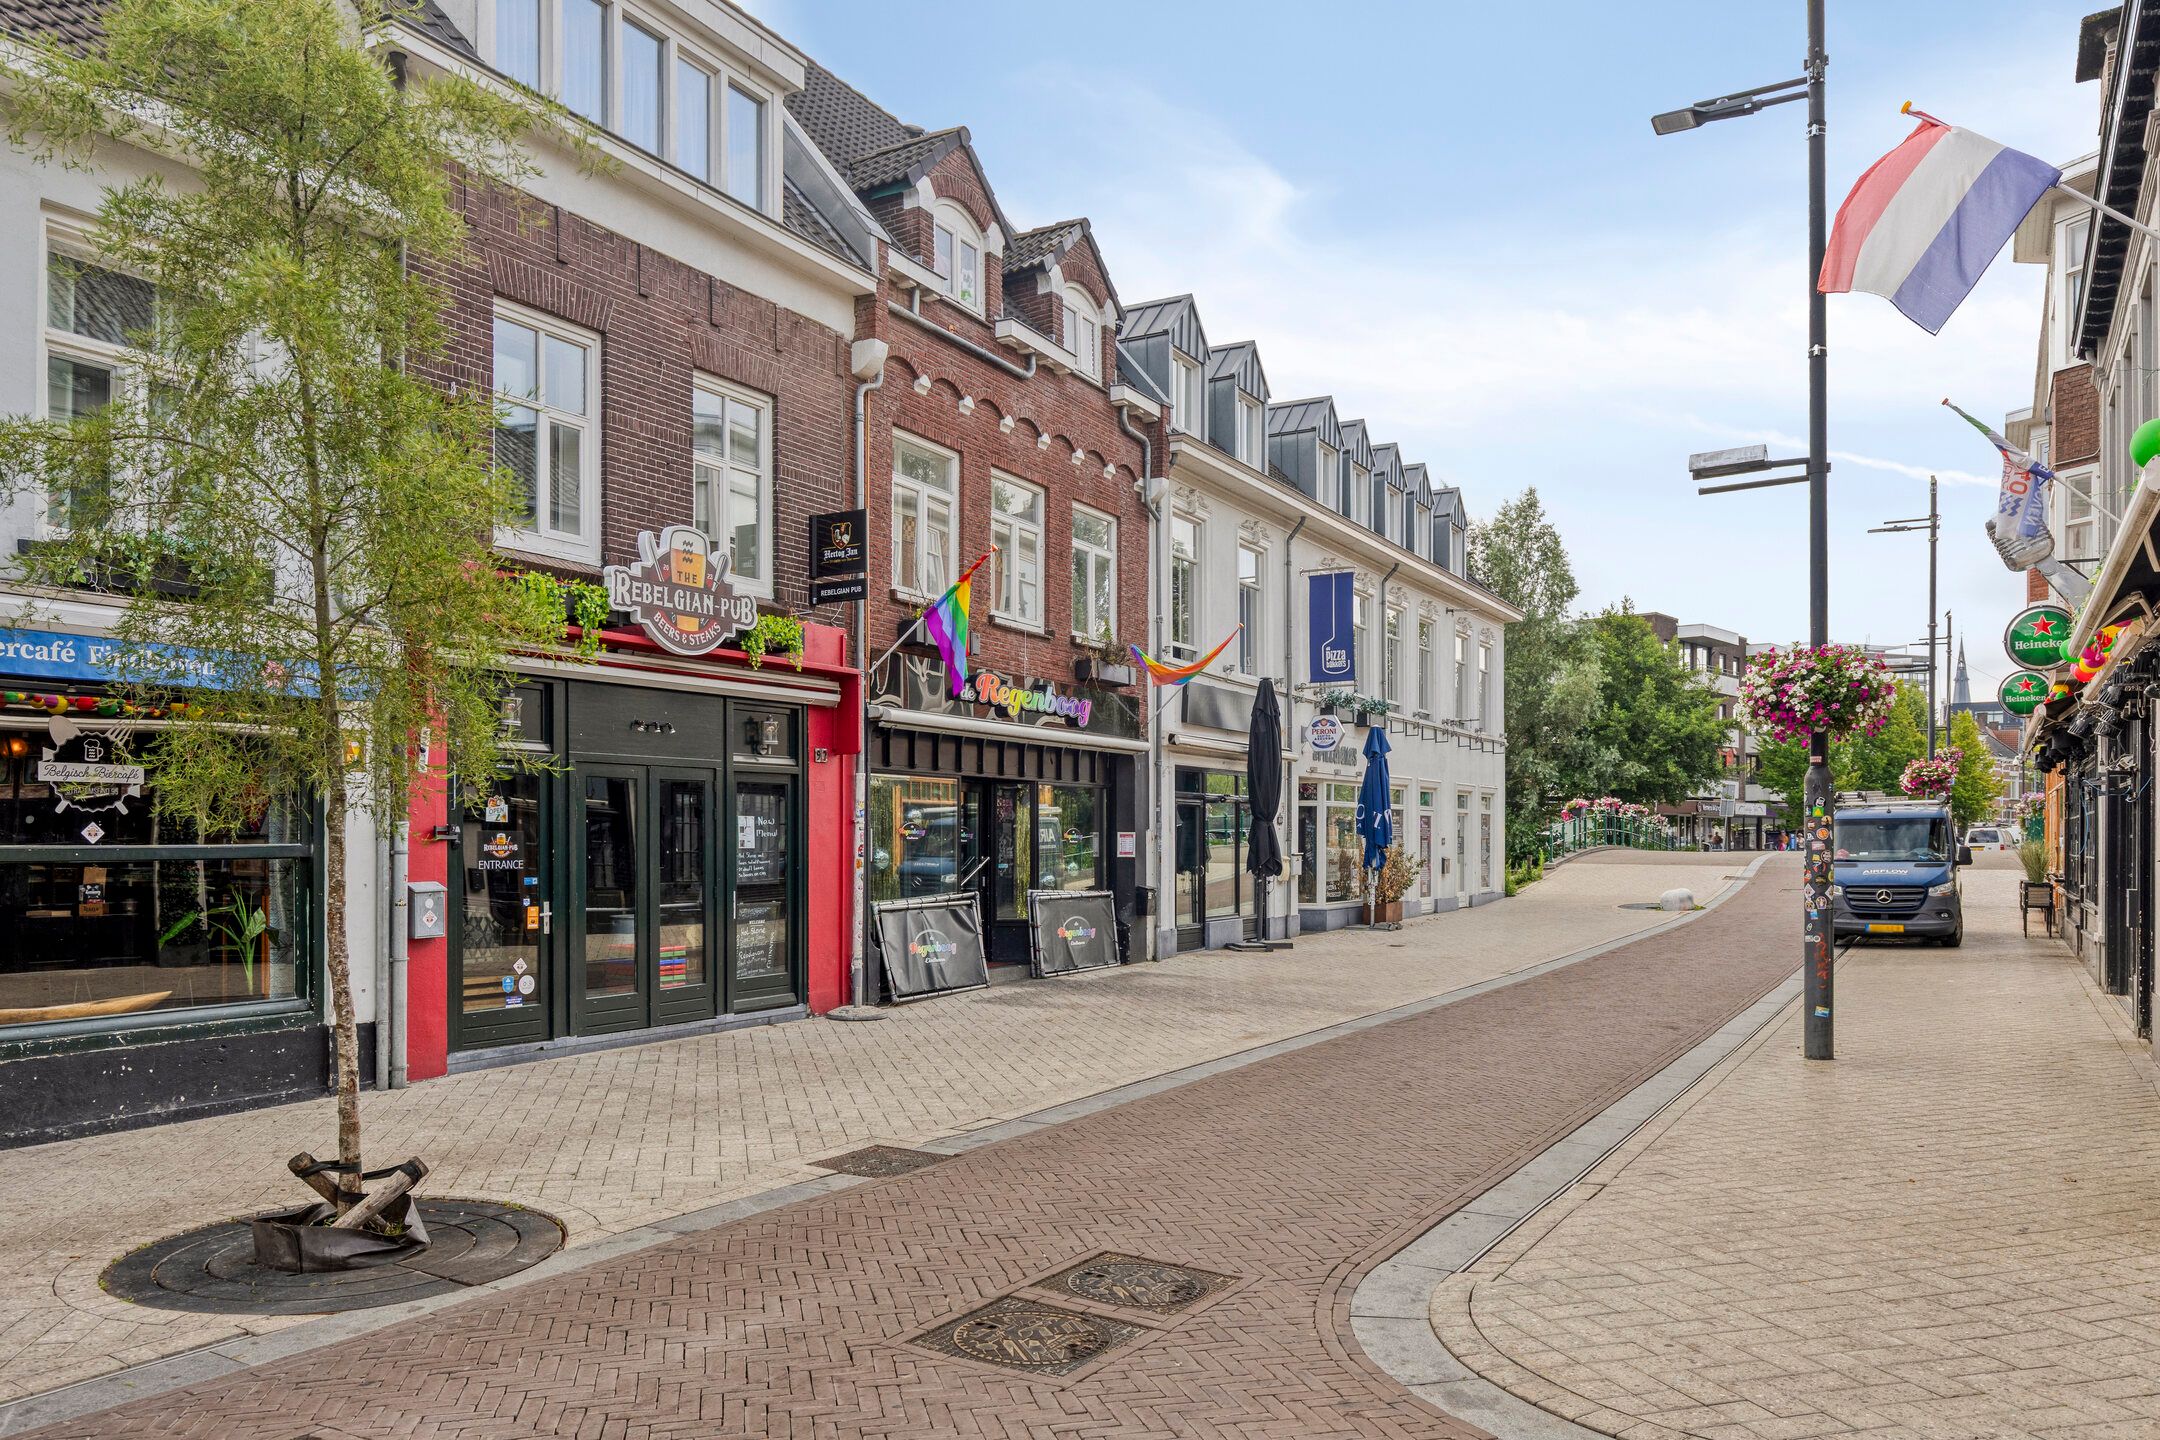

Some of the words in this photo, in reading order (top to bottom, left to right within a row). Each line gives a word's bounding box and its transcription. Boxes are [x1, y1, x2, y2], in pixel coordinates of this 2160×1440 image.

[823, 549, 845, 561] Hertog
[845, 547, 858, 559] Jan
[677, 570, 698, 584] THE
[820, 586, 850, 596] REBELGIAN
[850, 585, 862, 593] PUB
[653, 611, 680, 642] BEERS
[681, 634, 688, 644] &
[689, 622, 721, 646] STEAKS
[2015, 639, 2062, 650] Heineke
[960, 683, 976, 701] de
[976, 673, 1092, 728] Regenboog
[2005, 695, 2046, 703] Heineken
[43, 763, 91, 780] Belgisch
[94, 766, 140, 782] Biercafé
[488, 806, 505, 815] OPEN
[478, 859, 524, 870] ENTRANCE
